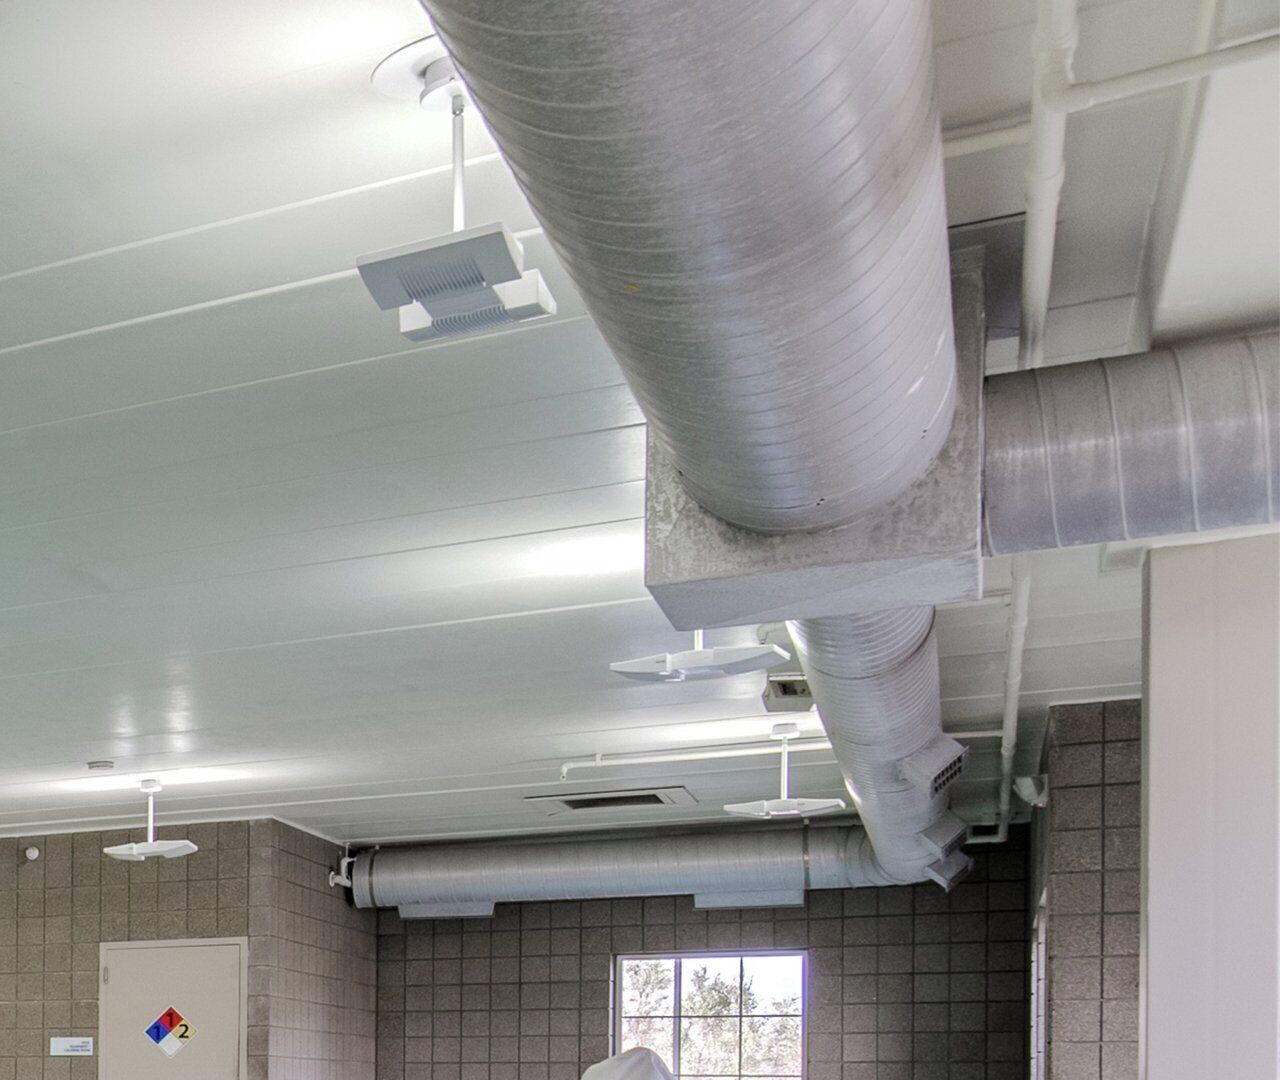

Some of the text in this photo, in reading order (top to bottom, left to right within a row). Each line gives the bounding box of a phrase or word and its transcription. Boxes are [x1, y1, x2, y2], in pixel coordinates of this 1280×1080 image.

[167, 1013, 174, 1027] 1
[153, 1024, 189, 1040] 1 2
